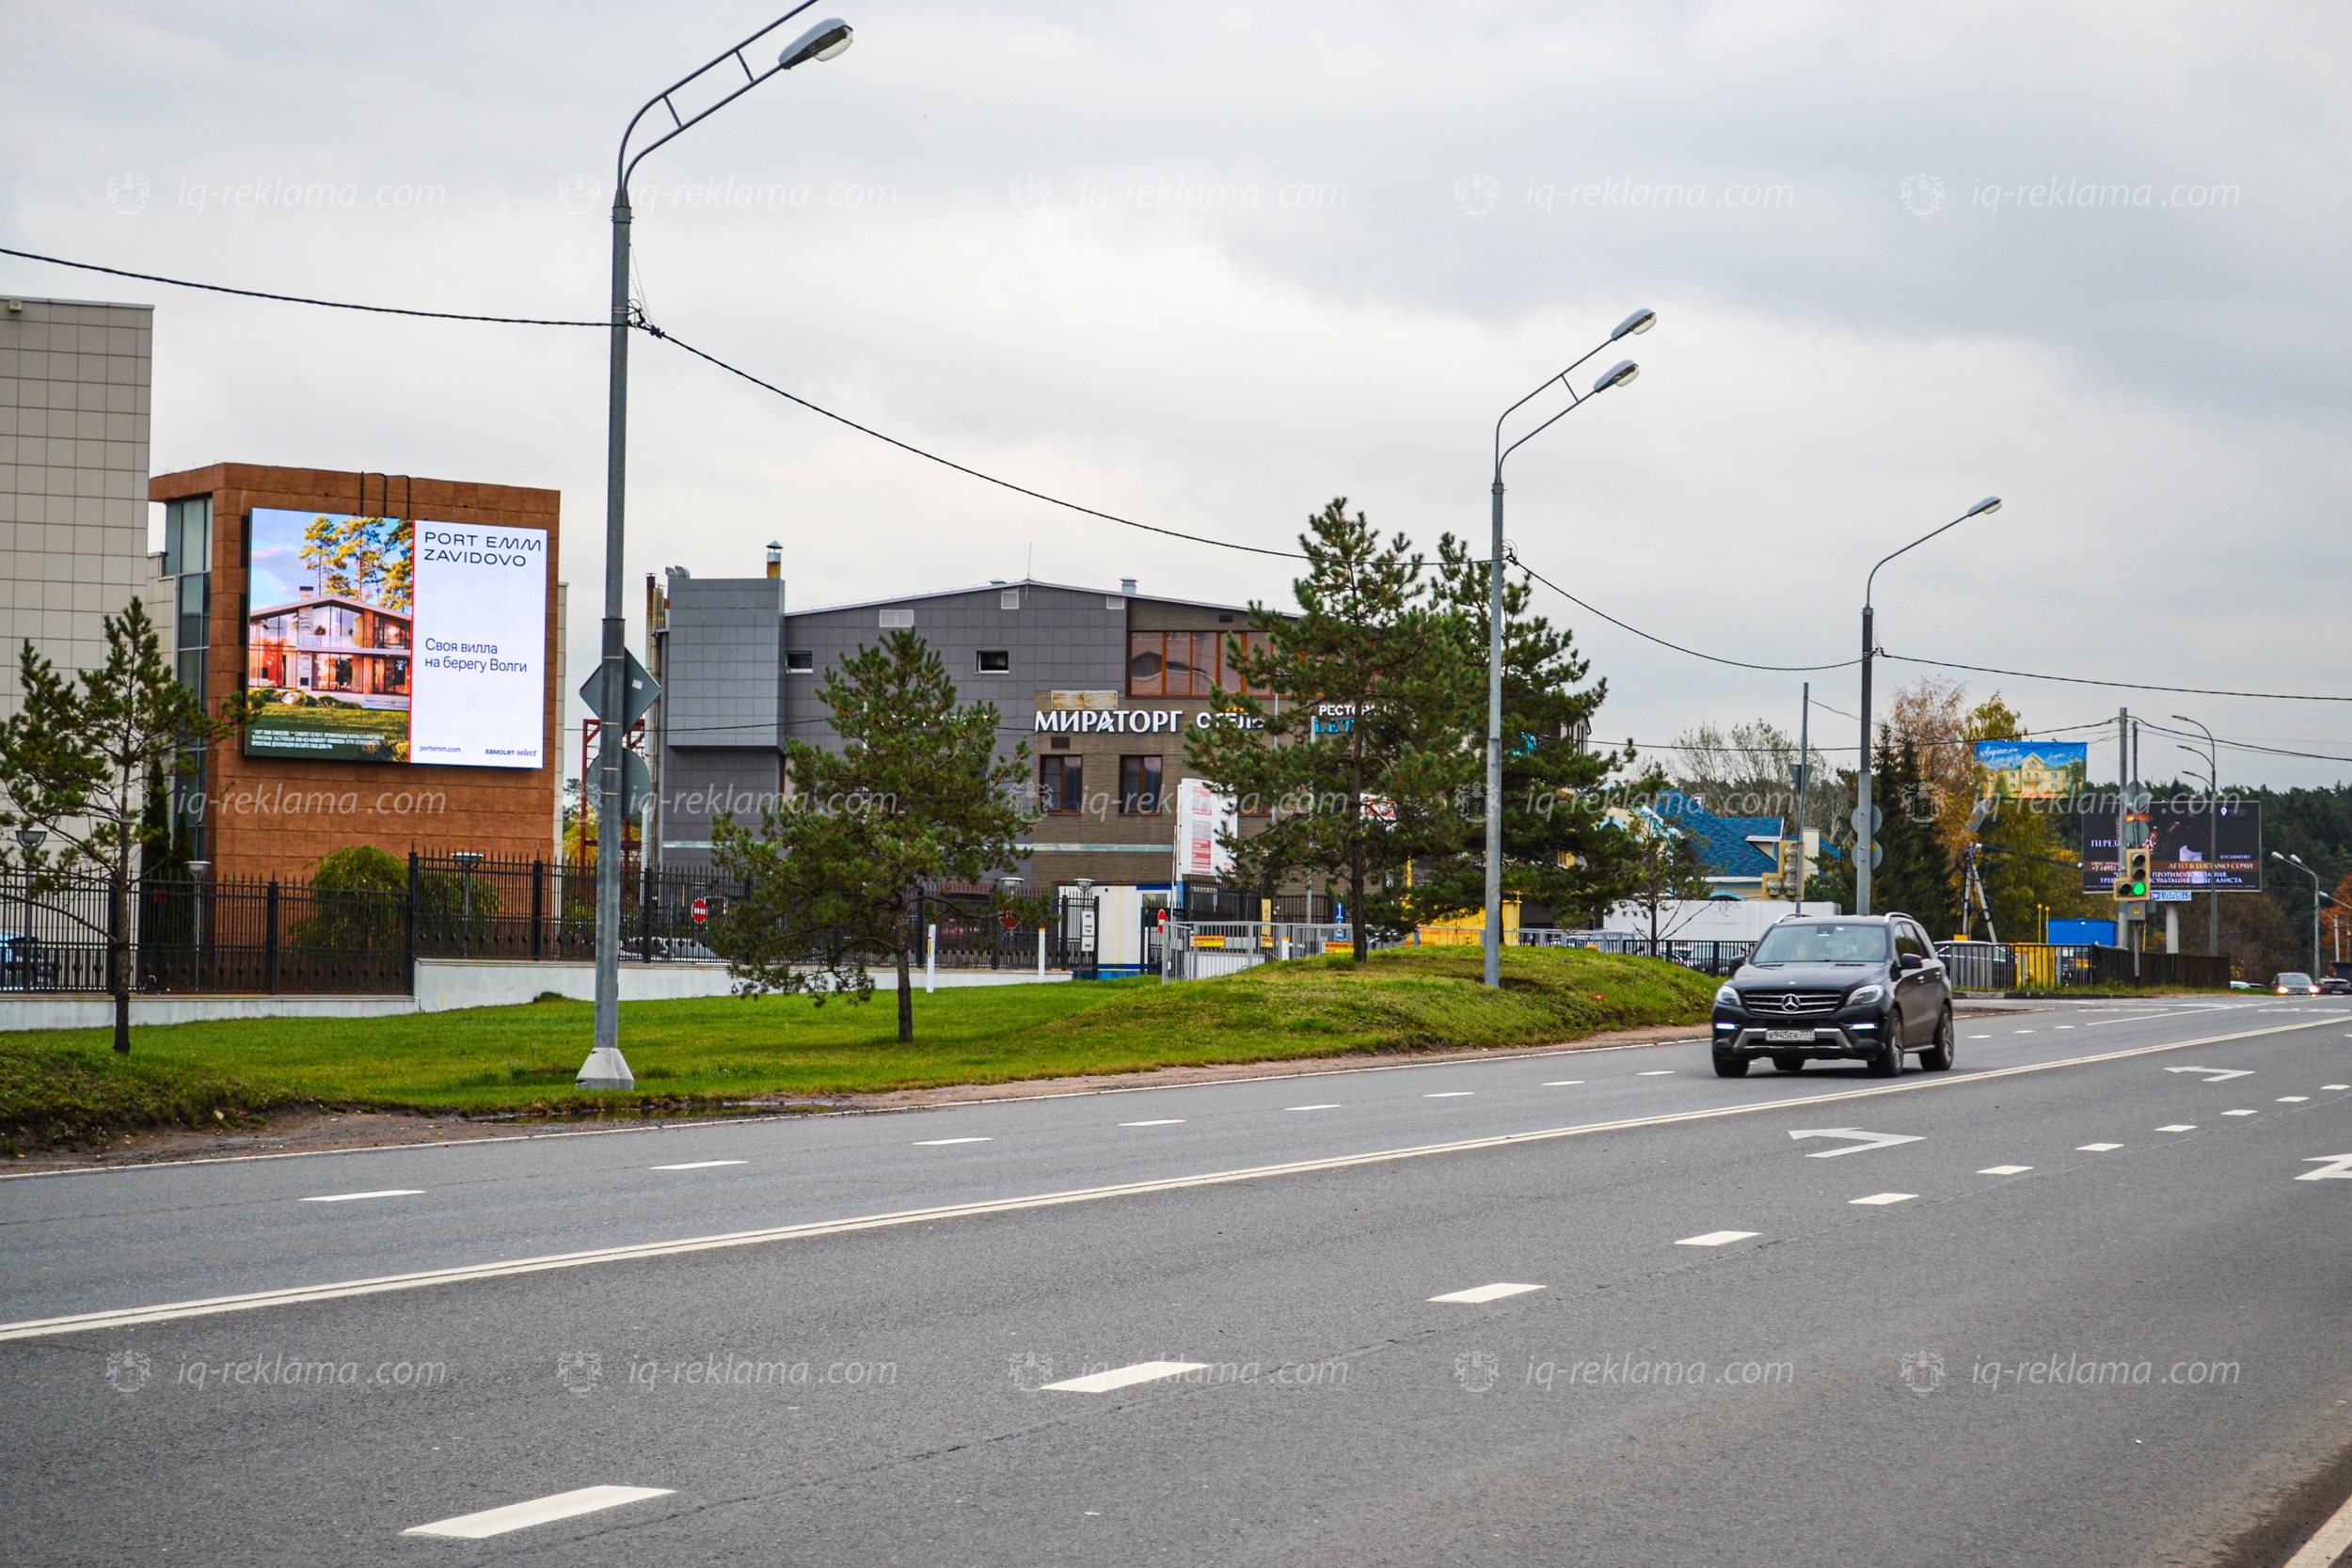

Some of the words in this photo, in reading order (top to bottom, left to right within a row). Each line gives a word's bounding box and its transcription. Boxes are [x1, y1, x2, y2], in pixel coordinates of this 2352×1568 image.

[424, 531, 478, 546] PORT
[423, 548, 527, 567] ZAVIDOVO
[425, 637, 458, 652] Своя
[461, 642, 498, 655] вилла
[424, 657, 440, 668] на
[443, 656, 487, 673] берегу
[490, 657, 528, 673] Волги
[1034, 709, 1184, 733] МИРАТОРГ
